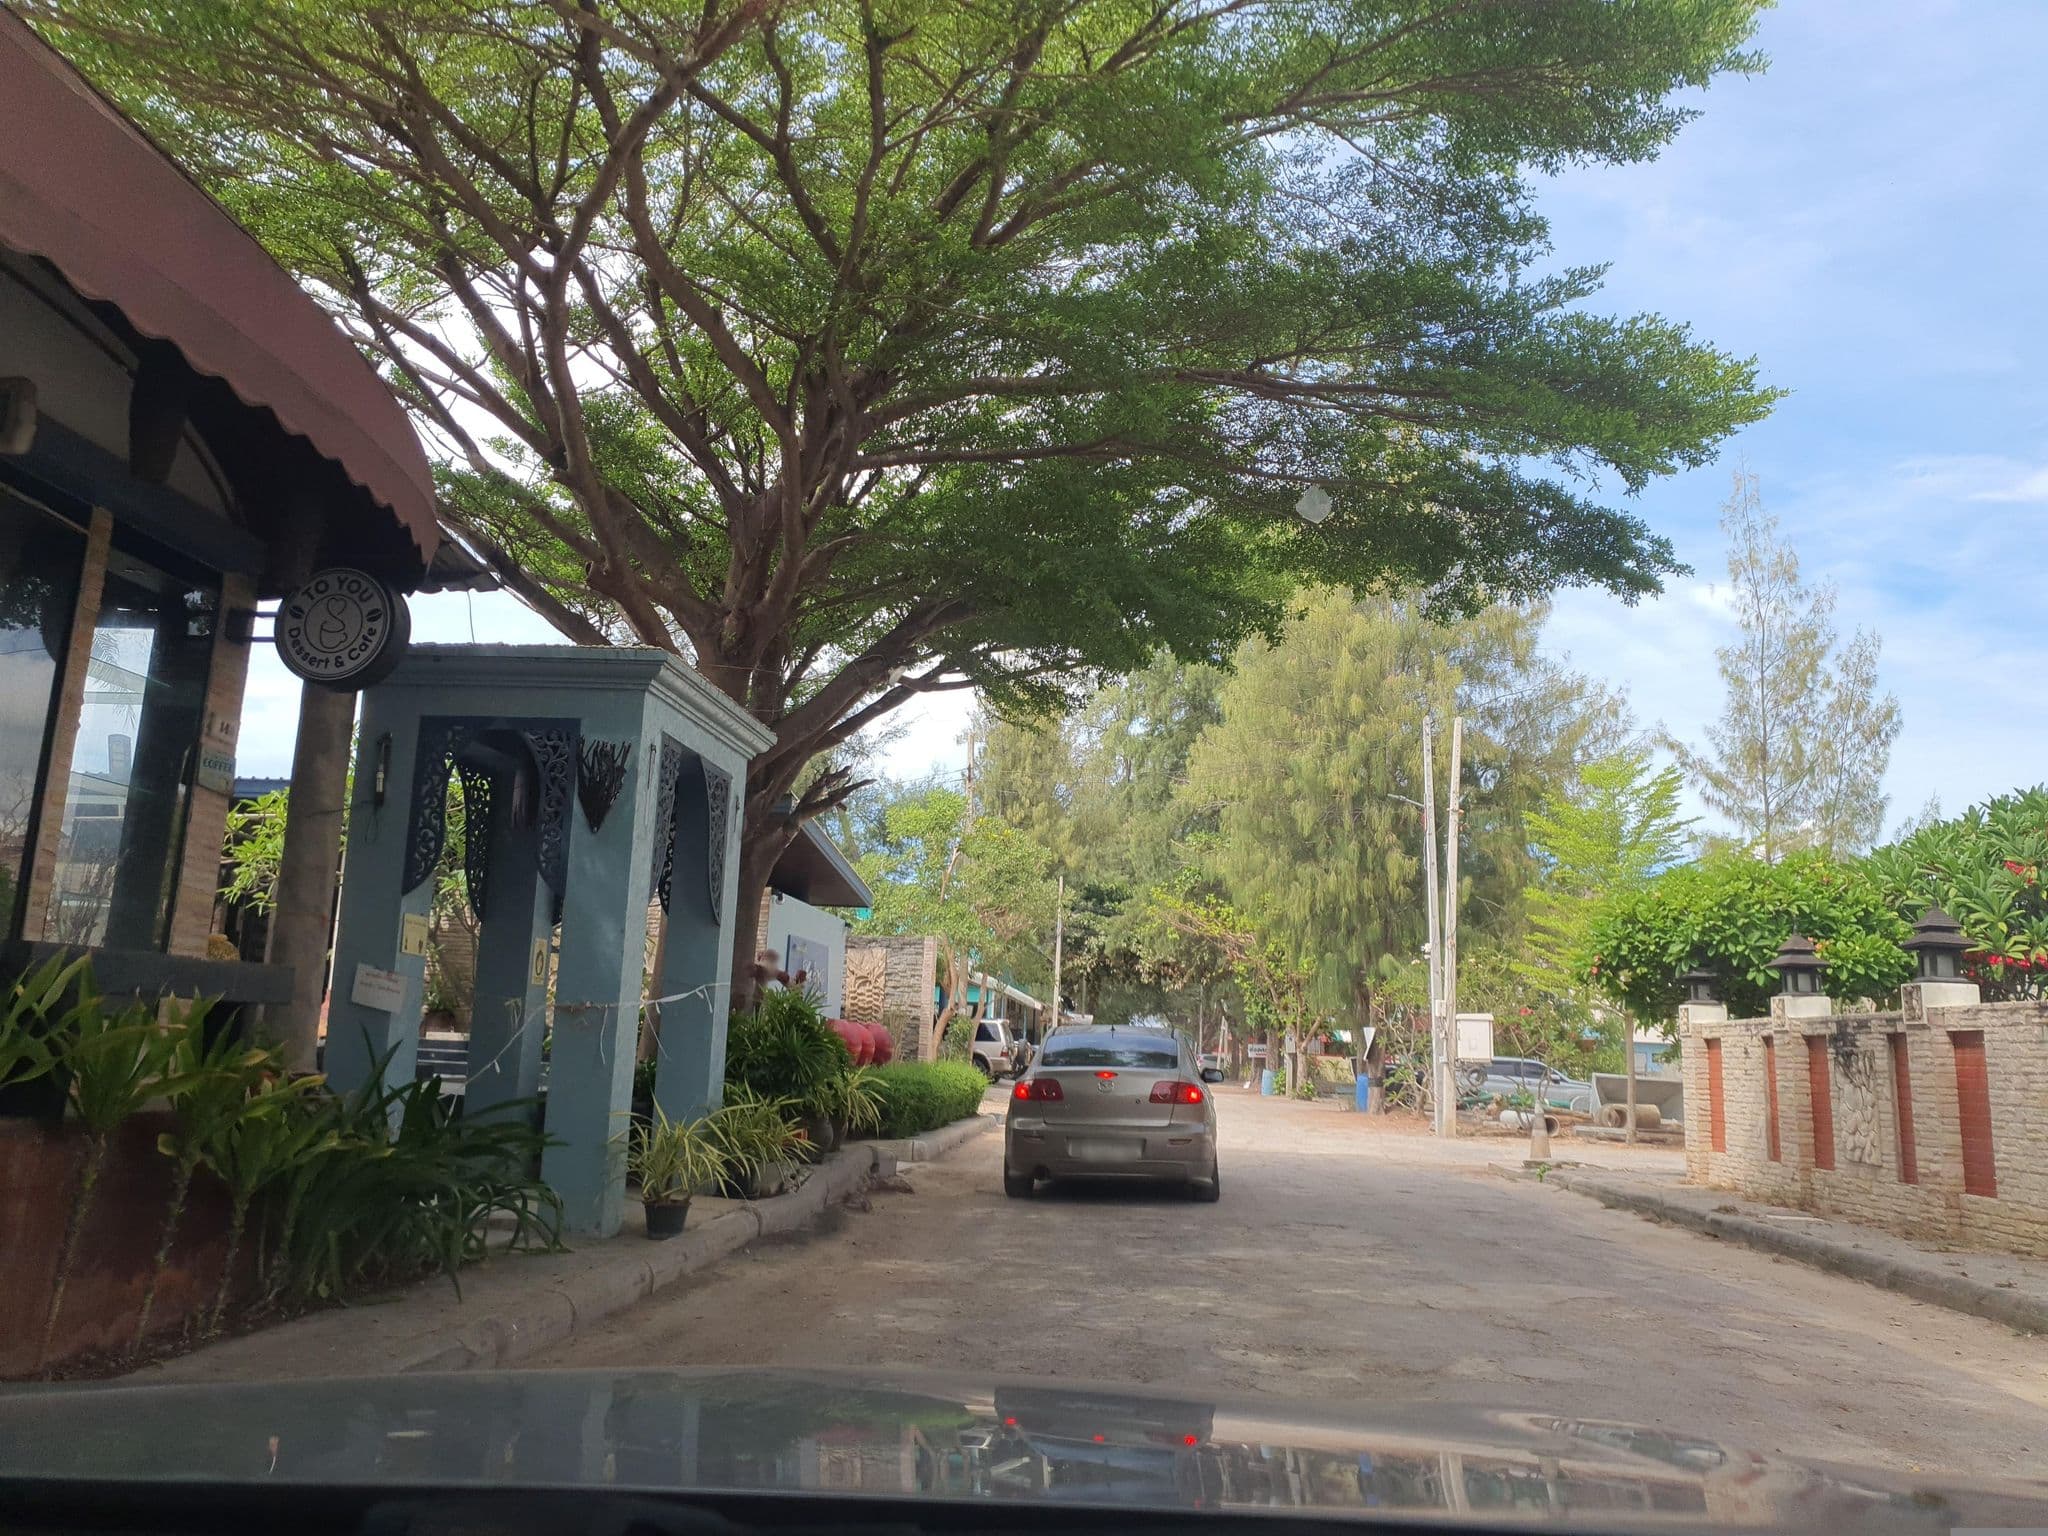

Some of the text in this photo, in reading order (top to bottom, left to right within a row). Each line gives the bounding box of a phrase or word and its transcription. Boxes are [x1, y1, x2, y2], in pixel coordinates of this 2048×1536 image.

[302, 576, 374, 602] TO YOU
[288, 627, 377, 669] Dessert & Cafe
